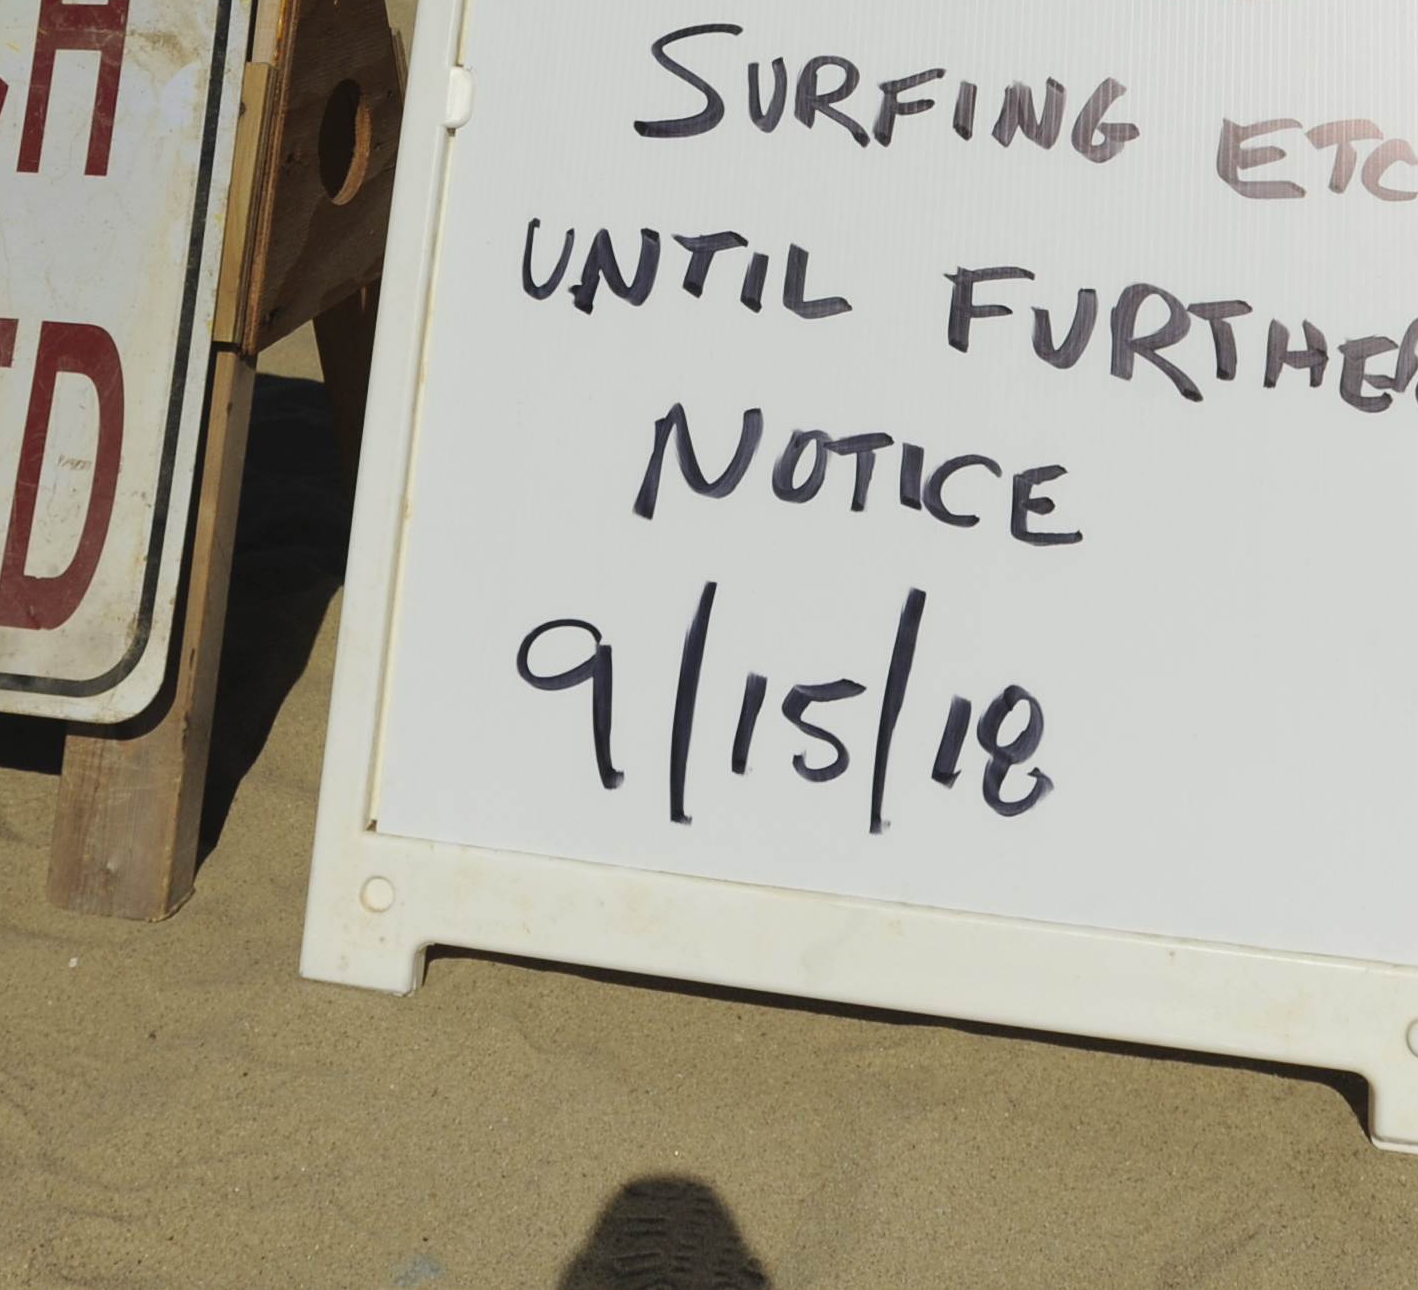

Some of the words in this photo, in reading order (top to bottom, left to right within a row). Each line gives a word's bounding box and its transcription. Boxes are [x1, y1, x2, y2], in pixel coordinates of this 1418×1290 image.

[632, 22, 1140, 164] SURFING
[521, 217, 853, 316] UNTIL
[632, 402, 1083, 546] NOTICE
[516, 580, 1054, 835] 9/15/18
